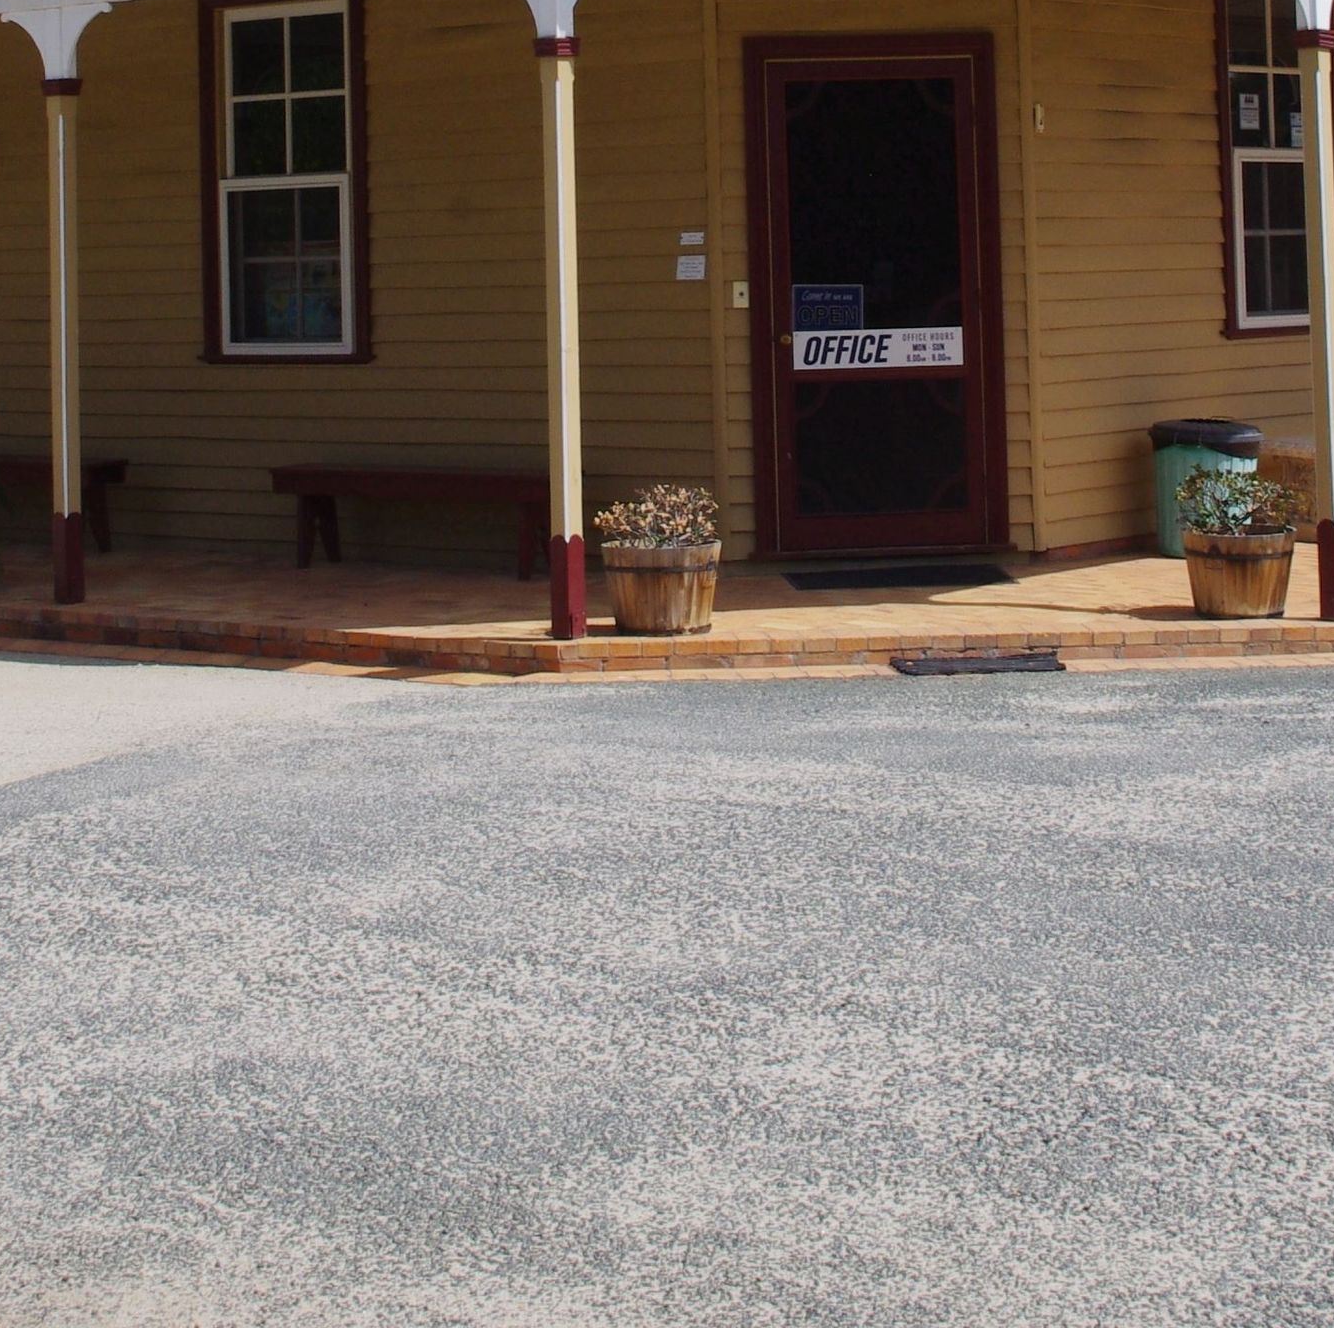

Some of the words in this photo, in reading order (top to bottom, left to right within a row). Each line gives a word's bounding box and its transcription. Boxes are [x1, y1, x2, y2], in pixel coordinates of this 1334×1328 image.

[797, 305, 859, 325] OPEN
[902, 332, 927, 342] OFFICE
[930, 331, 955, 341] HOURS
[803, 334, 892, 366] OFFICE
[912, 343, 927, 351] MON
[932, 343, 945, 351] SUN
